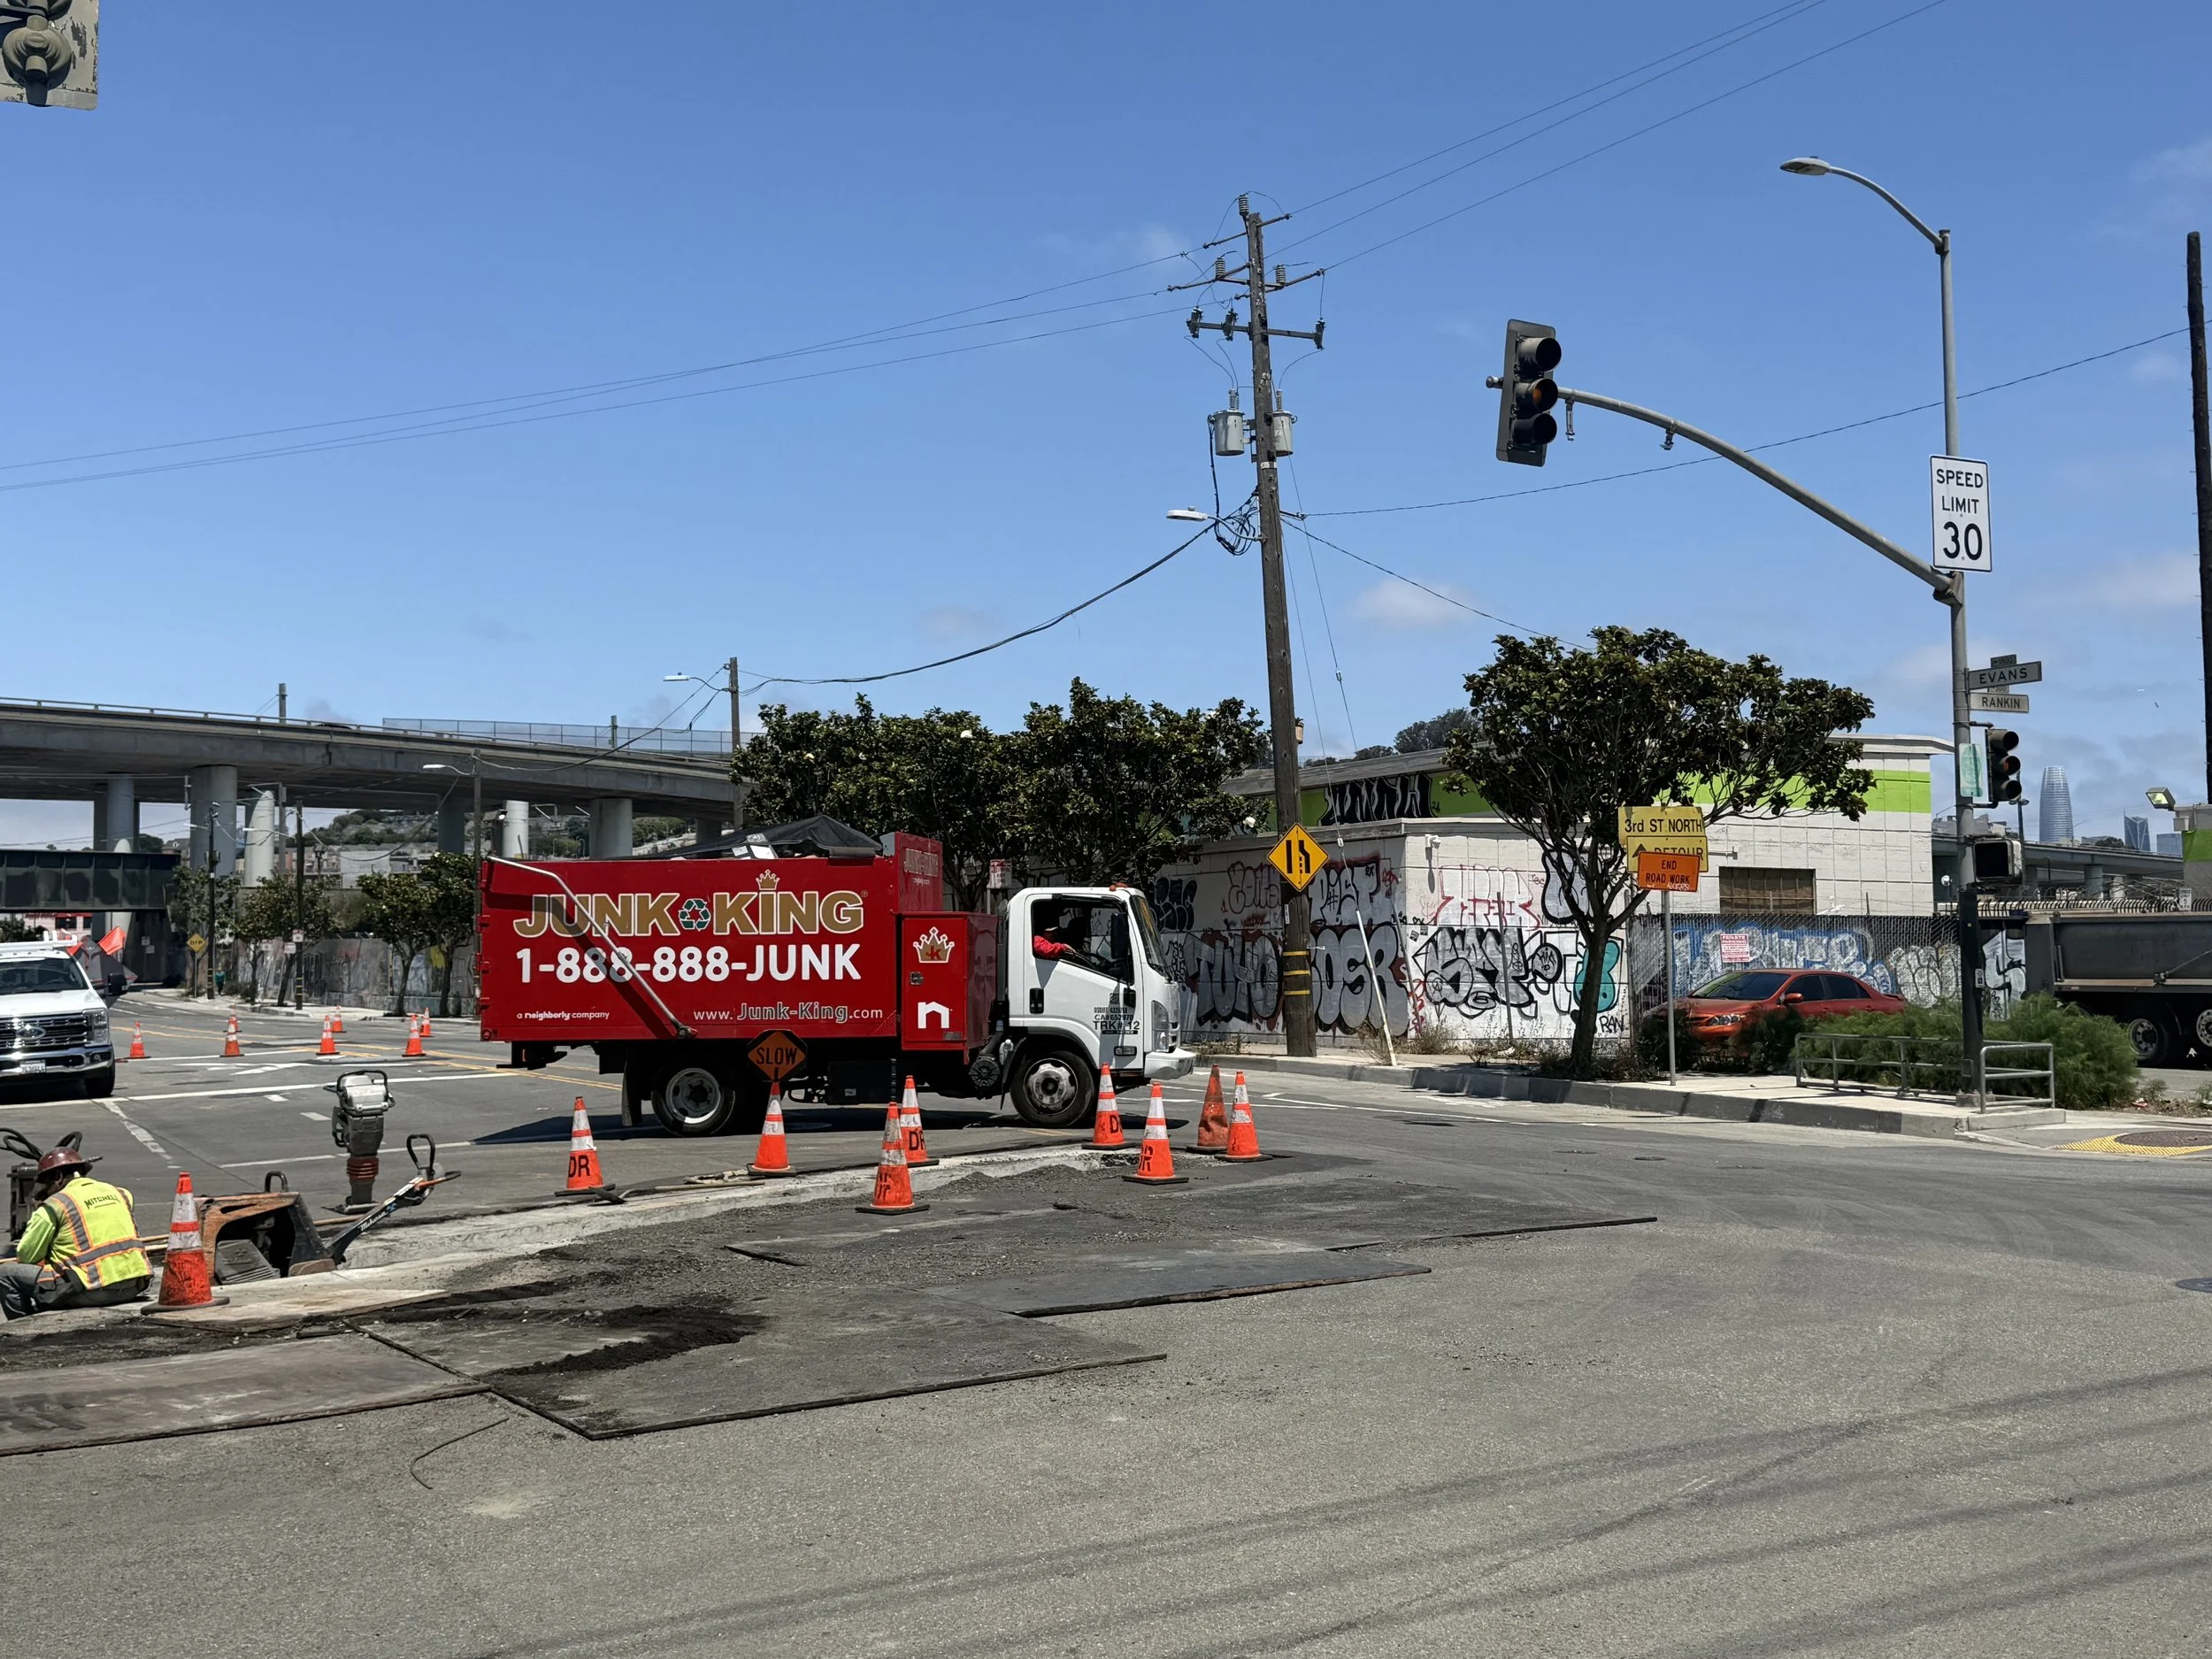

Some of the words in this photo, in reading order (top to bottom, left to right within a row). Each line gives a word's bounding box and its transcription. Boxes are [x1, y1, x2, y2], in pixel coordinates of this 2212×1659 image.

[1936, 468, 1984, 488] SPEED
[1941, 495, 1980, 514] LIMIT
[1943, 520, 1983, 561] 30
[1978, 667, 2028, 685] EVANS
[1981, 696, 2021, 709] RANKIN
[1624, 818, 1644, 833] 3rd
[1649, 818, 1664, 833] ST
[1668, 818, 1702, 833] NORTH
[1661, 859, 1678, 871] END
[1645, 872, 1666, 884] ROAD
[1670, 875, 1690, 885] WORK
[512, 892, 681, 939] JUNK
[712, 889, 864, 935] KING
[516, 942, 862, 984] 1-888-888-JUNK
[525, 1010, 570, 1021] neighborly
[572, 1011, 610, 1020] company
[1092, 1020, 1123, 1031] TRK#
[1127, 1020, 1141, 1030] 12
[756, 1047, 797, 1065] SLOW
[568, 1154, 591, 1179] DR
[83, 1194, 121, 1210] MITCHELL
